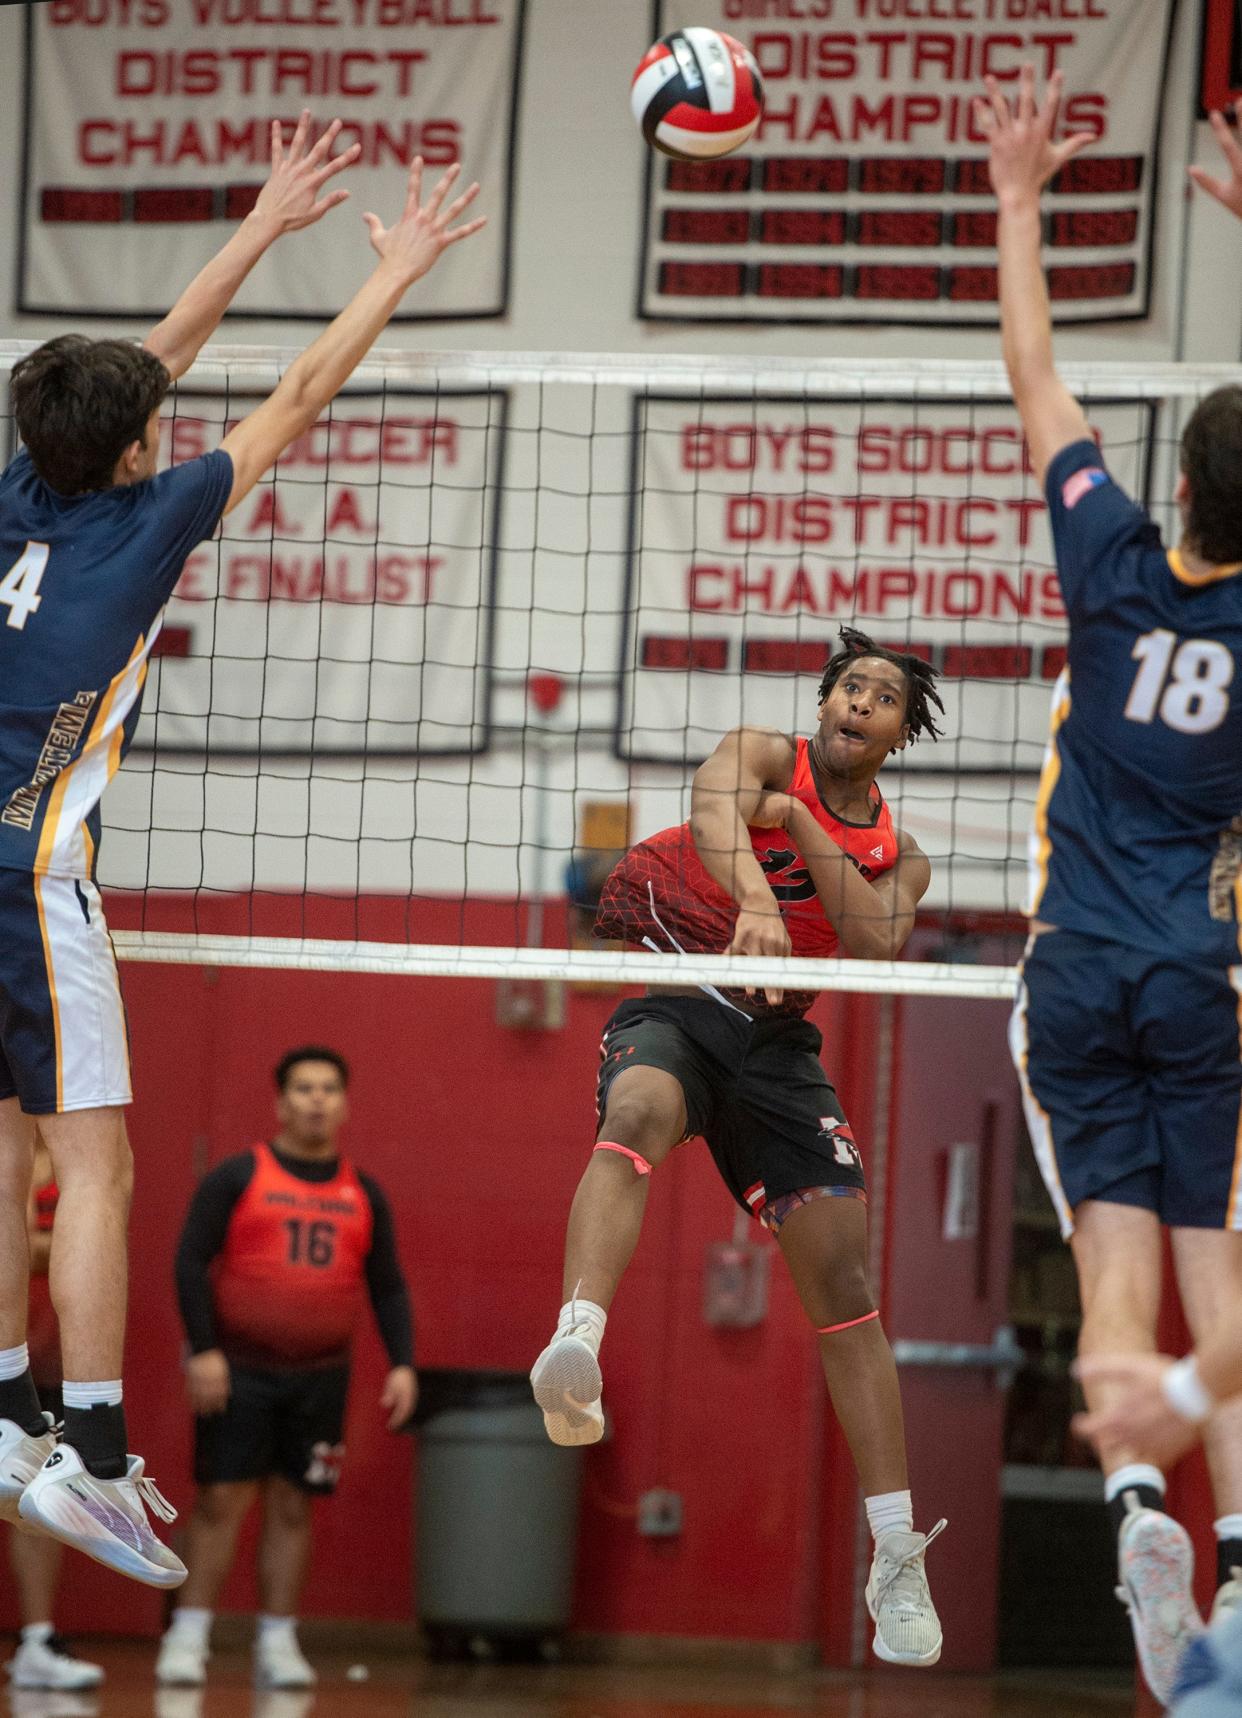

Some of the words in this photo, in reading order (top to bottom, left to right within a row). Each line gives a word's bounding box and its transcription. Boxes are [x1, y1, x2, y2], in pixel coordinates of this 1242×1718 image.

[115, 48, 428, 97] DISTRICT
[751, 32, 1076, 82] DISTRICT
[681, 423, 835, 474] BOYS
[856, 425, 1103, 478] SOCC
[723, 496, 1048, 548] DISTRICT
[0, 540, 50, 631] 4
[227, 554, 445, 604] FINALIST
[687, 563, 1068, 619] CHAMPIONS
[1123, 627, 1235, 734] 18
[284, 1218, 336, 1268] 16
